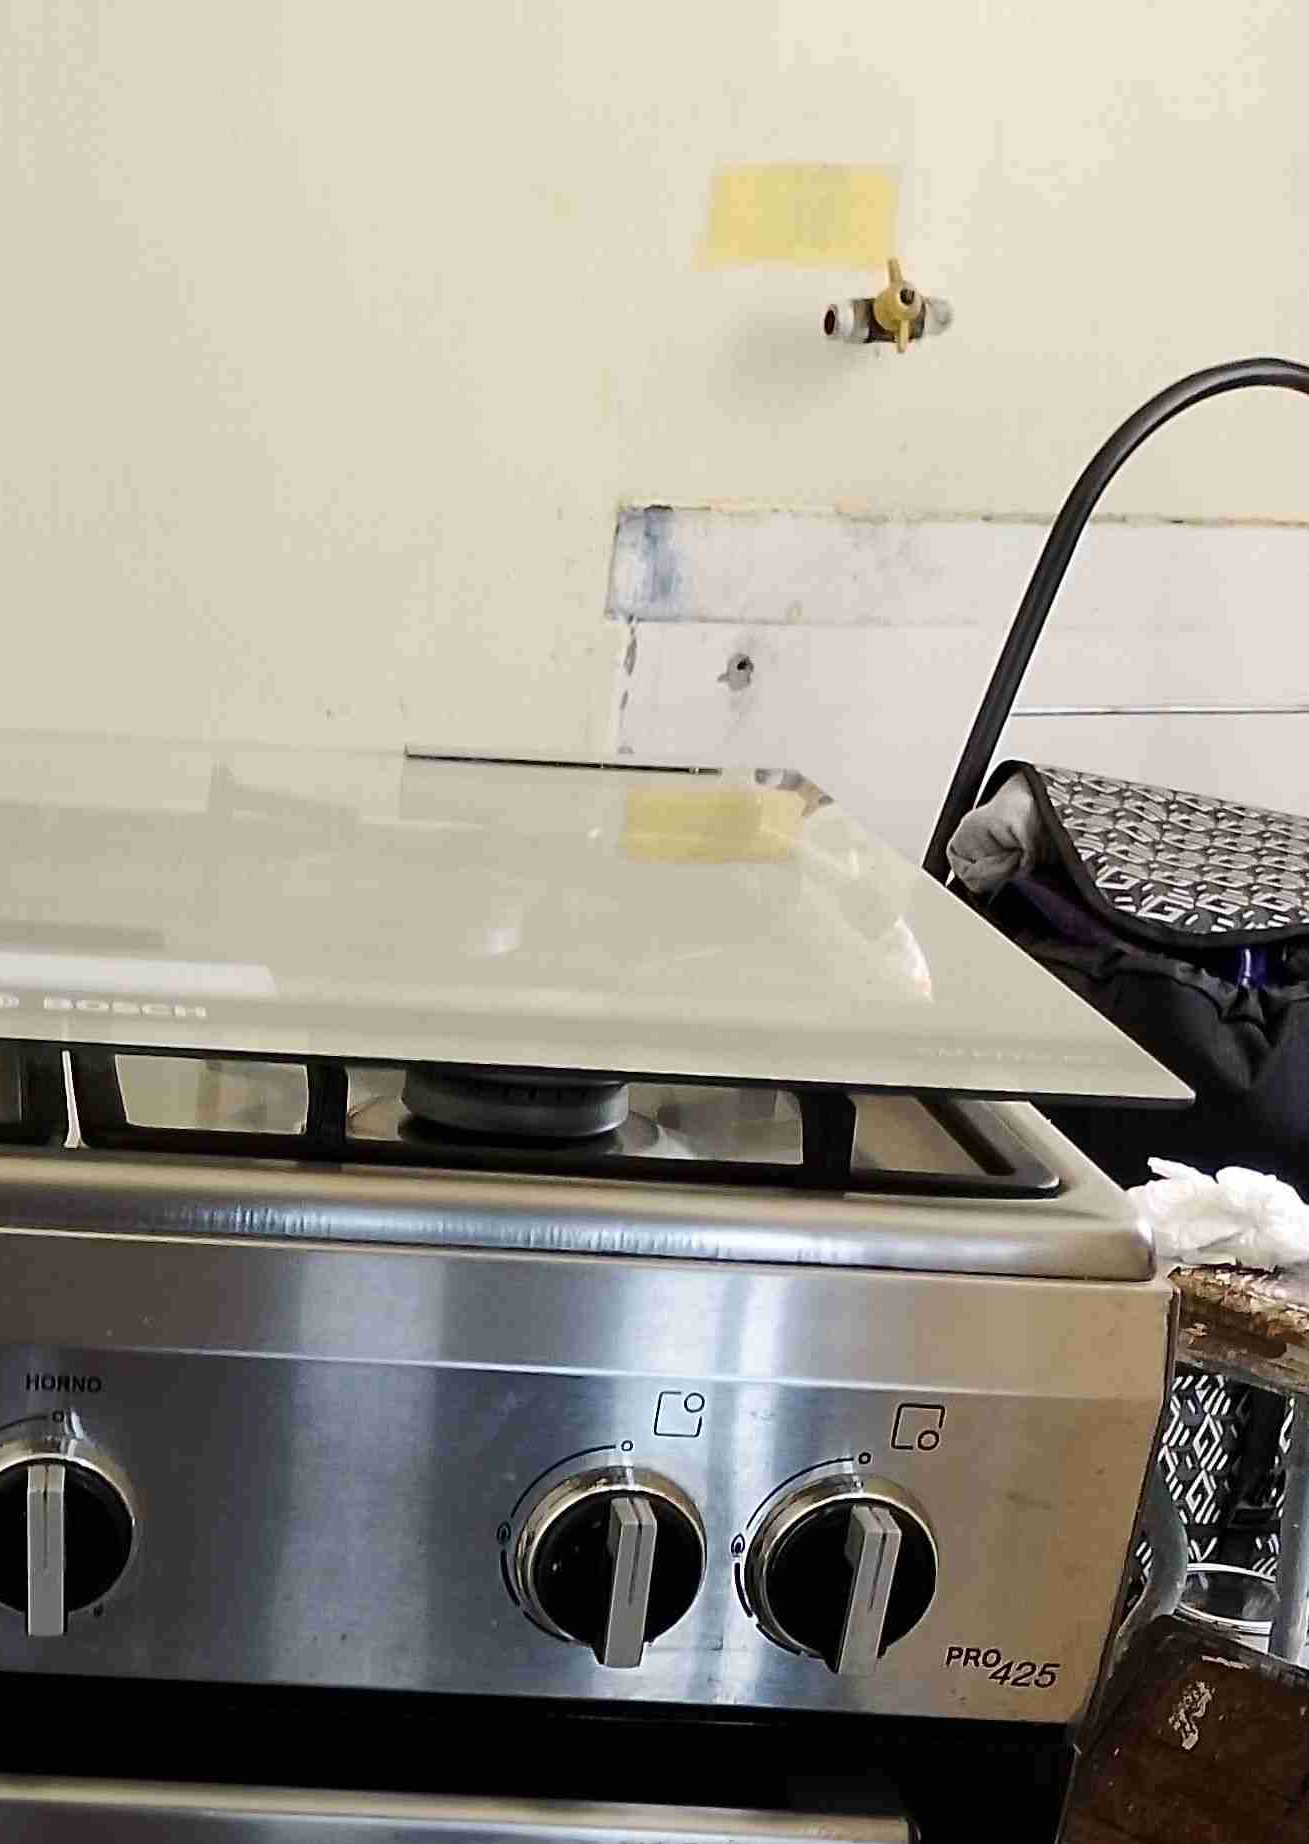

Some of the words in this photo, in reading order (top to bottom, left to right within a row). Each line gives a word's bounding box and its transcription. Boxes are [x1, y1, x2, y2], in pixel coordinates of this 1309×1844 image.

[43, 996, 208, 1019] BOSCH
[26, 1373, 102, 1393] HORNO
[946, 1646, 1003, 1668] PRO
[989, 1660, 1061, 1689] 425
